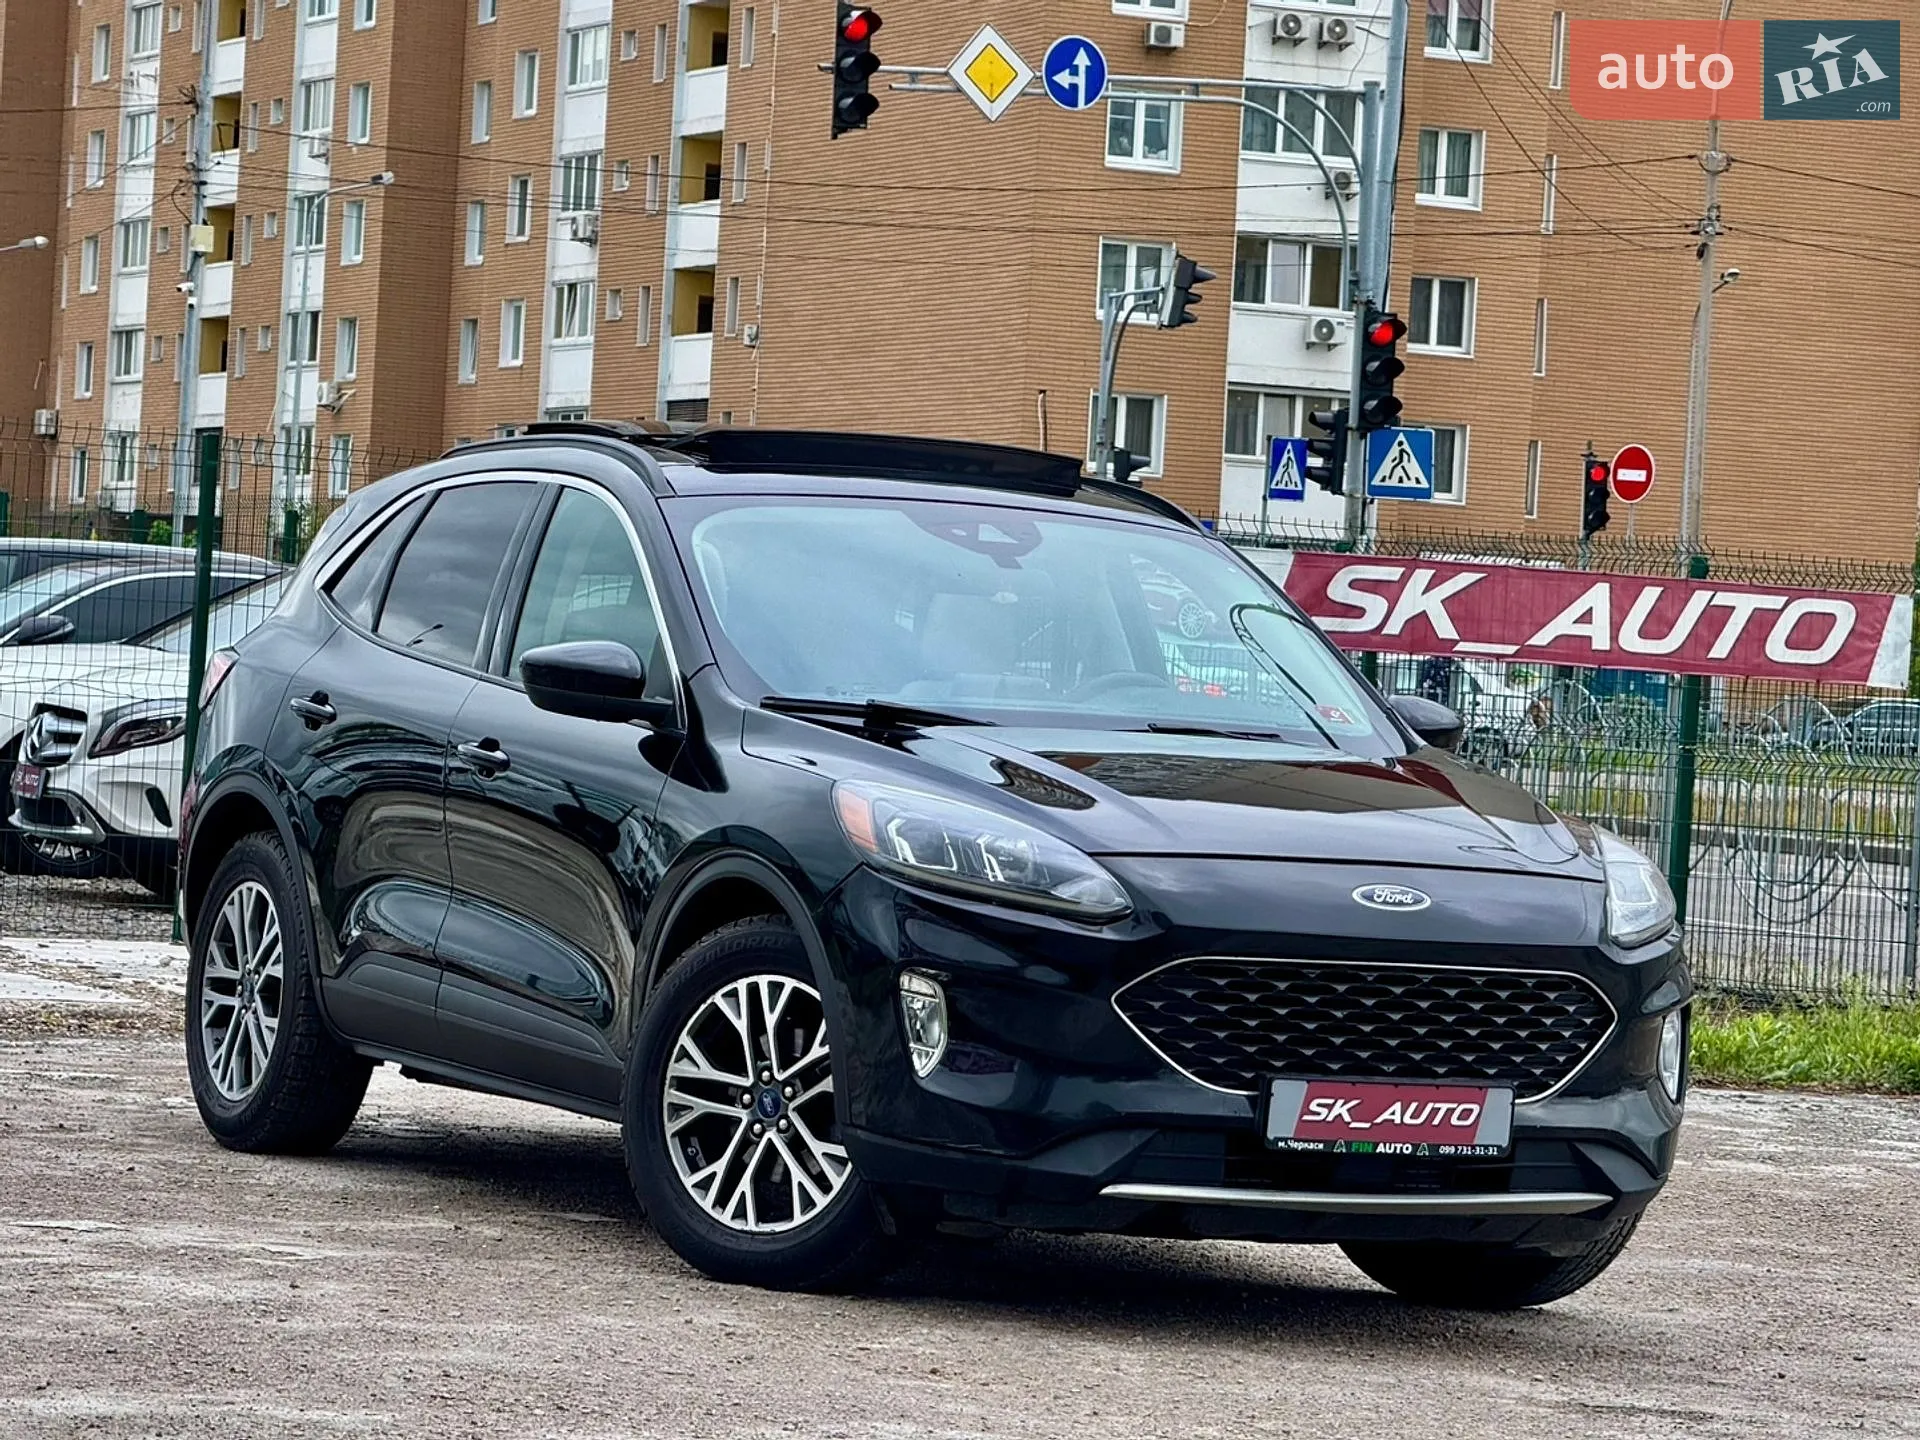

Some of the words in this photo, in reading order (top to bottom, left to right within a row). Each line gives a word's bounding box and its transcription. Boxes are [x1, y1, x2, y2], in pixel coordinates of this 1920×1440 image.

[1311, 565, 1857, 665] SK_AUTO
[1373, 887, 1415, 904] Ford
[1301, 1098, 1482, 1129] SK_AUTO
[1351, 1142, 1373, 1153] FIN
[1376, 1143, 1412, 1154] AUTO
[1439, 1145, 1455, 1155] 099
[1457, 1146, 1498, 1155] 731-31-31
